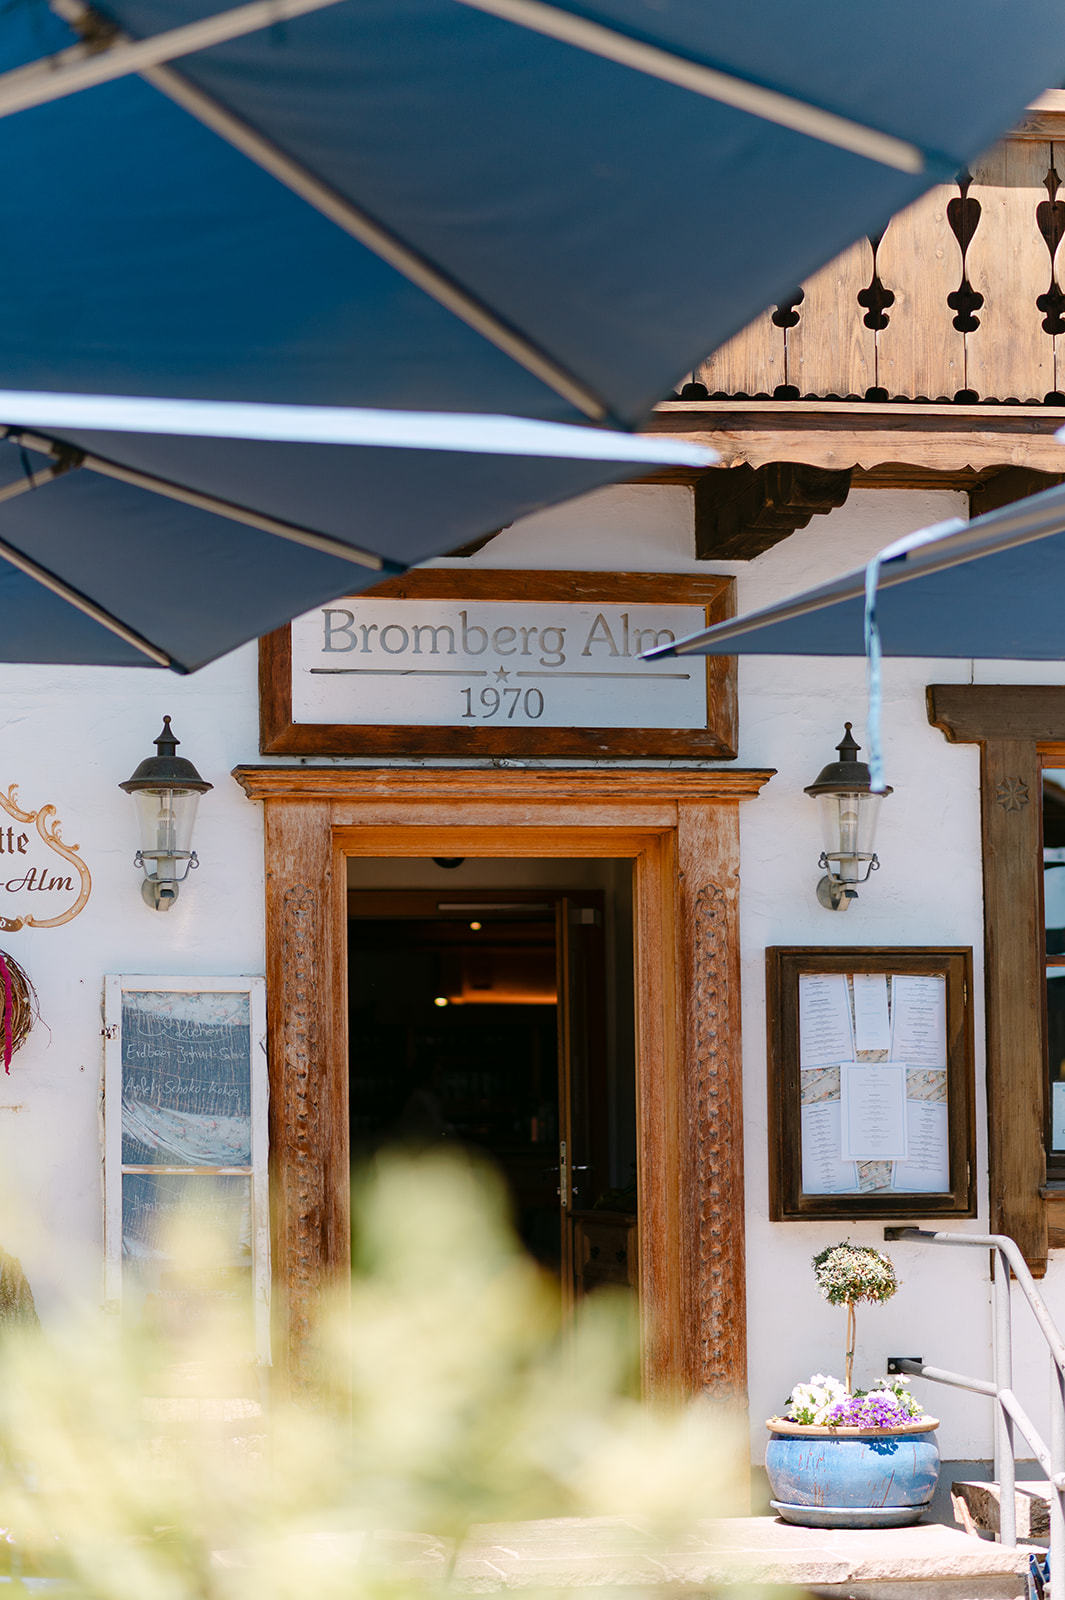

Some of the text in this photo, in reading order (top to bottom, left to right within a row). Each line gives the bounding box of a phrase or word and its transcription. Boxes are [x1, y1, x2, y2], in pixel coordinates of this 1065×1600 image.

[321, 608, 678, 667] Bromberg Alm
[460, 687, 545, 719] 1970
